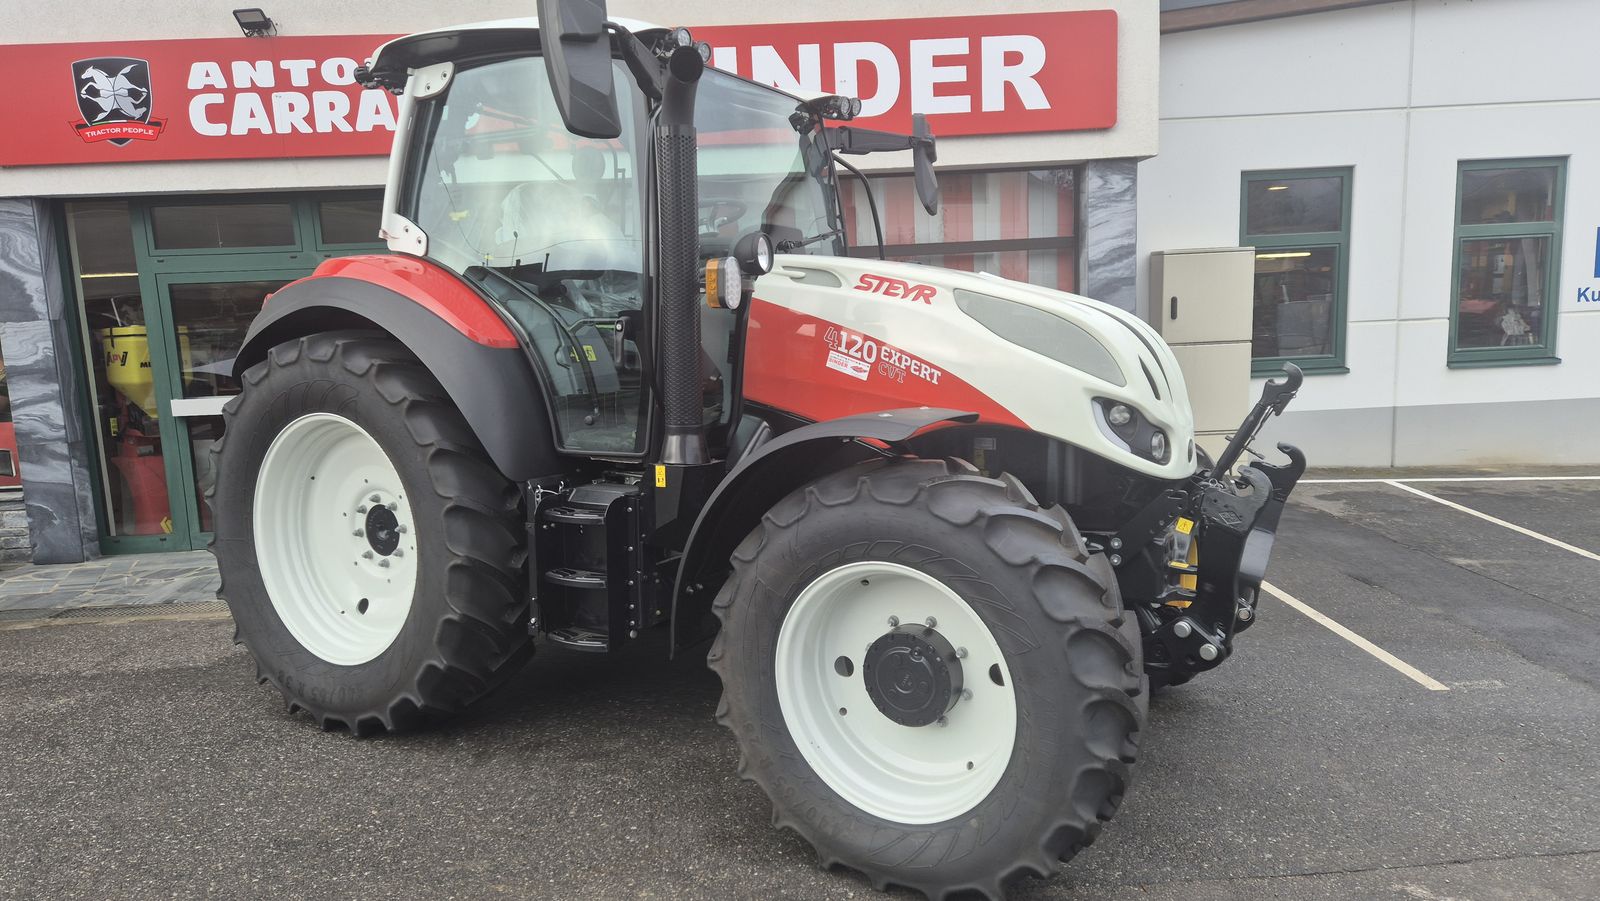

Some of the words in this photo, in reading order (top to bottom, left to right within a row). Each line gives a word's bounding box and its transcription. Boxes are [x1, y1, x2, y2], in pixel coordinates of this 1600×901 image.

[188, 90, 402, 136] CARRA
[85, 127, 121, 138] TRACTOR
[122, 127, 154, 136] PEOPLE
[853, 273, 937, 305] STEYR
[824, 326, 878, 363] 4120
[880, 346, 941, 385] EXPERT
[878, 362, 906, 384] CVT
